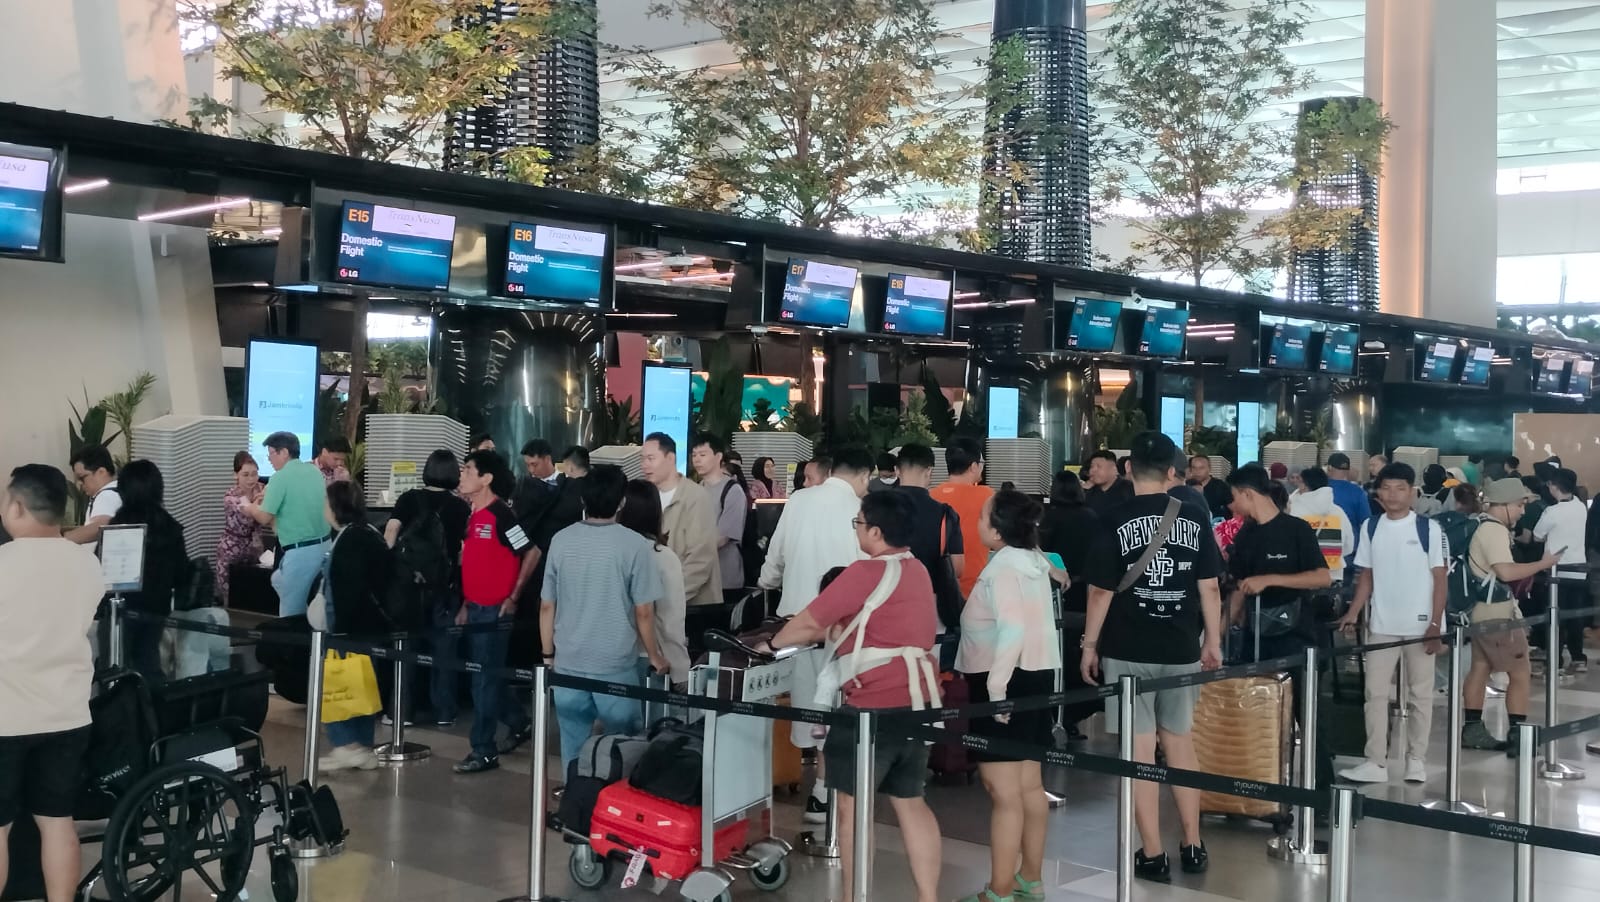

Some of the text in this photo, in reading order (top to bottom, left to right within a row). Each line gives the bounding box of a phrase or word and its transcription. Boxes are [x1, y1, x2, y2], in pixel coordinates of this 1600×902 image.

[348, 208, 370, 223] E15
[341, 232, 383, 247] Domestic
[514, 228, 533, 242] E16
[340, 244, 364, 258] Flight
[508, 251, 545, 264] Domestic
[507, 261, 529, 273] Flight
[348, 270, 358, 278] LG
[783, 293, 800, 303] Flight
[1117, 514, 1201, 556] NEW ORK
[1136, 764, 1168, 776] injourney
[1233, 781, 1268, 793] injourney
[1489, 822, 1529, 836] injourney
